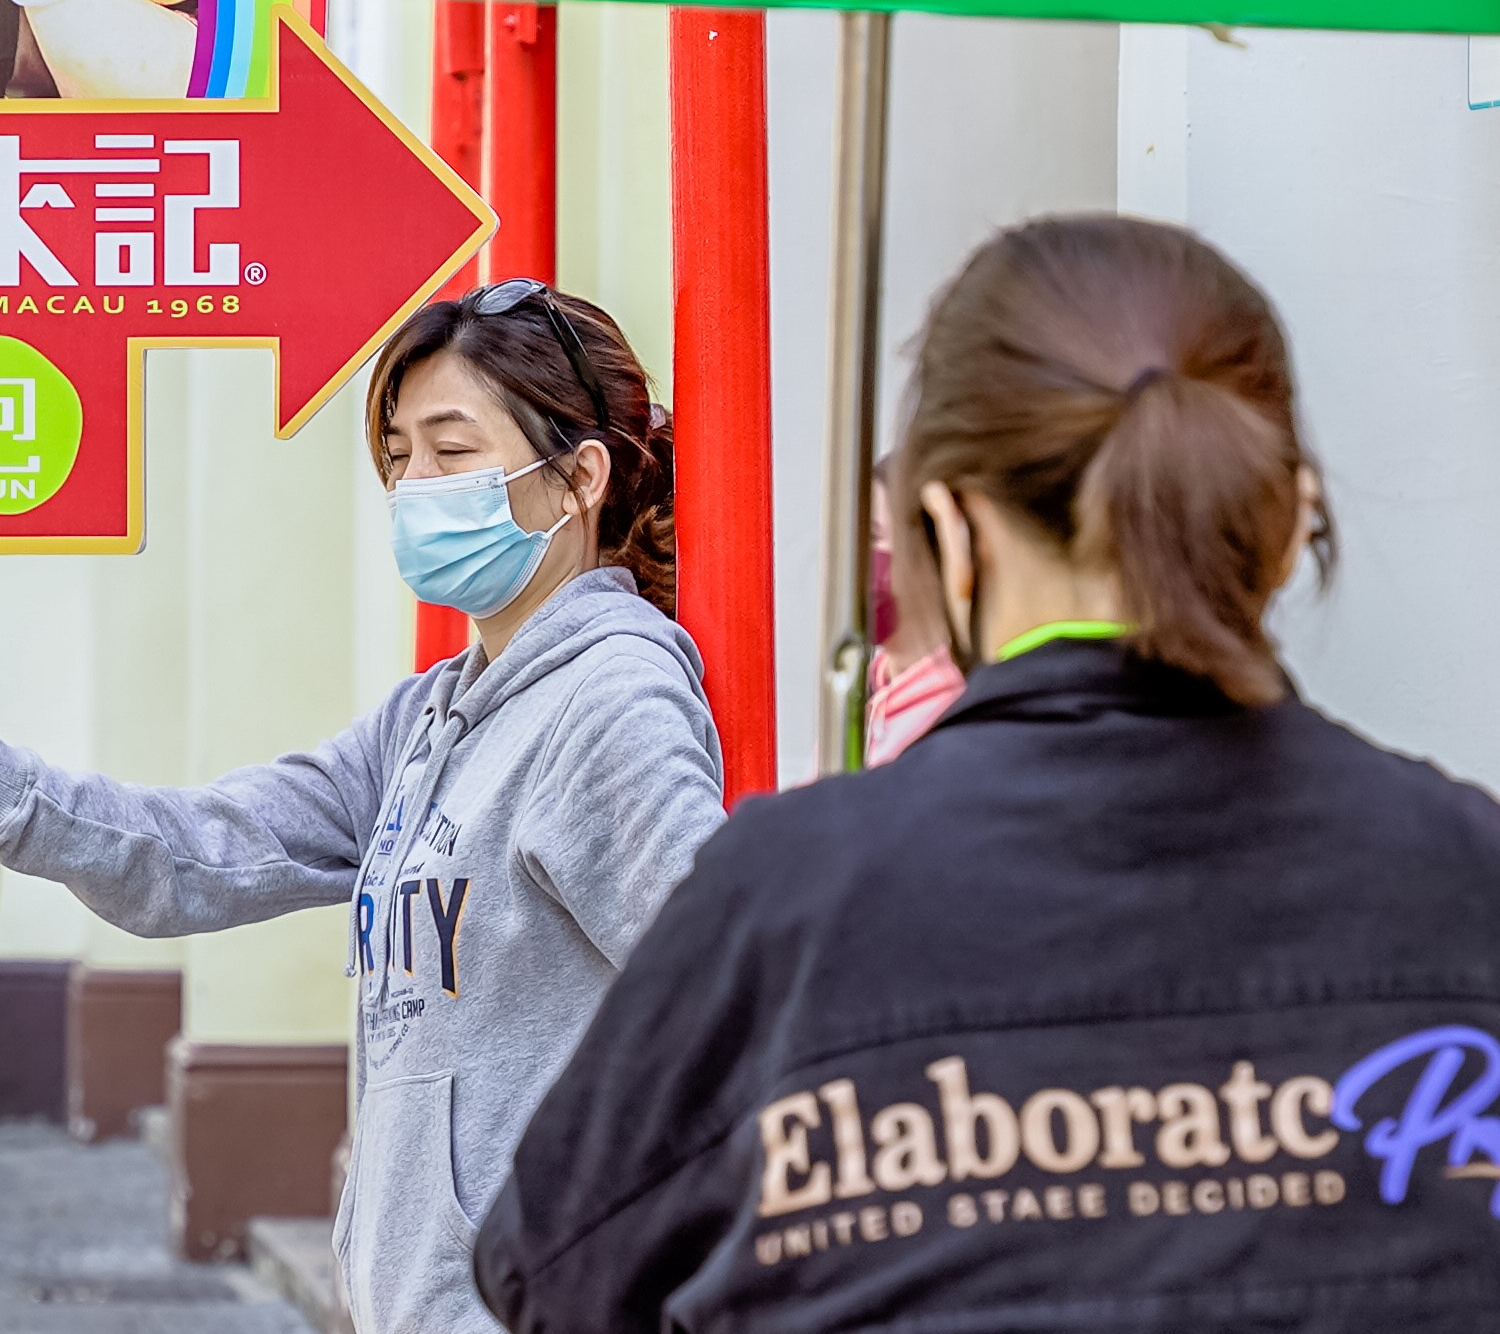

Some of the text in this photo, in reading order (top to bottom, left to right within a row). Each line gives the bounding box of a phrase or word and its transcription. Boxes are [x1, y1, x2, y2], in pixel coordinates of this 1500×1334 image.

[145, 295, 241, 319] 1968
[754, 1200, 924, 1266] UNITED
[1127, 1169, 1346, 1217] DECIDED
